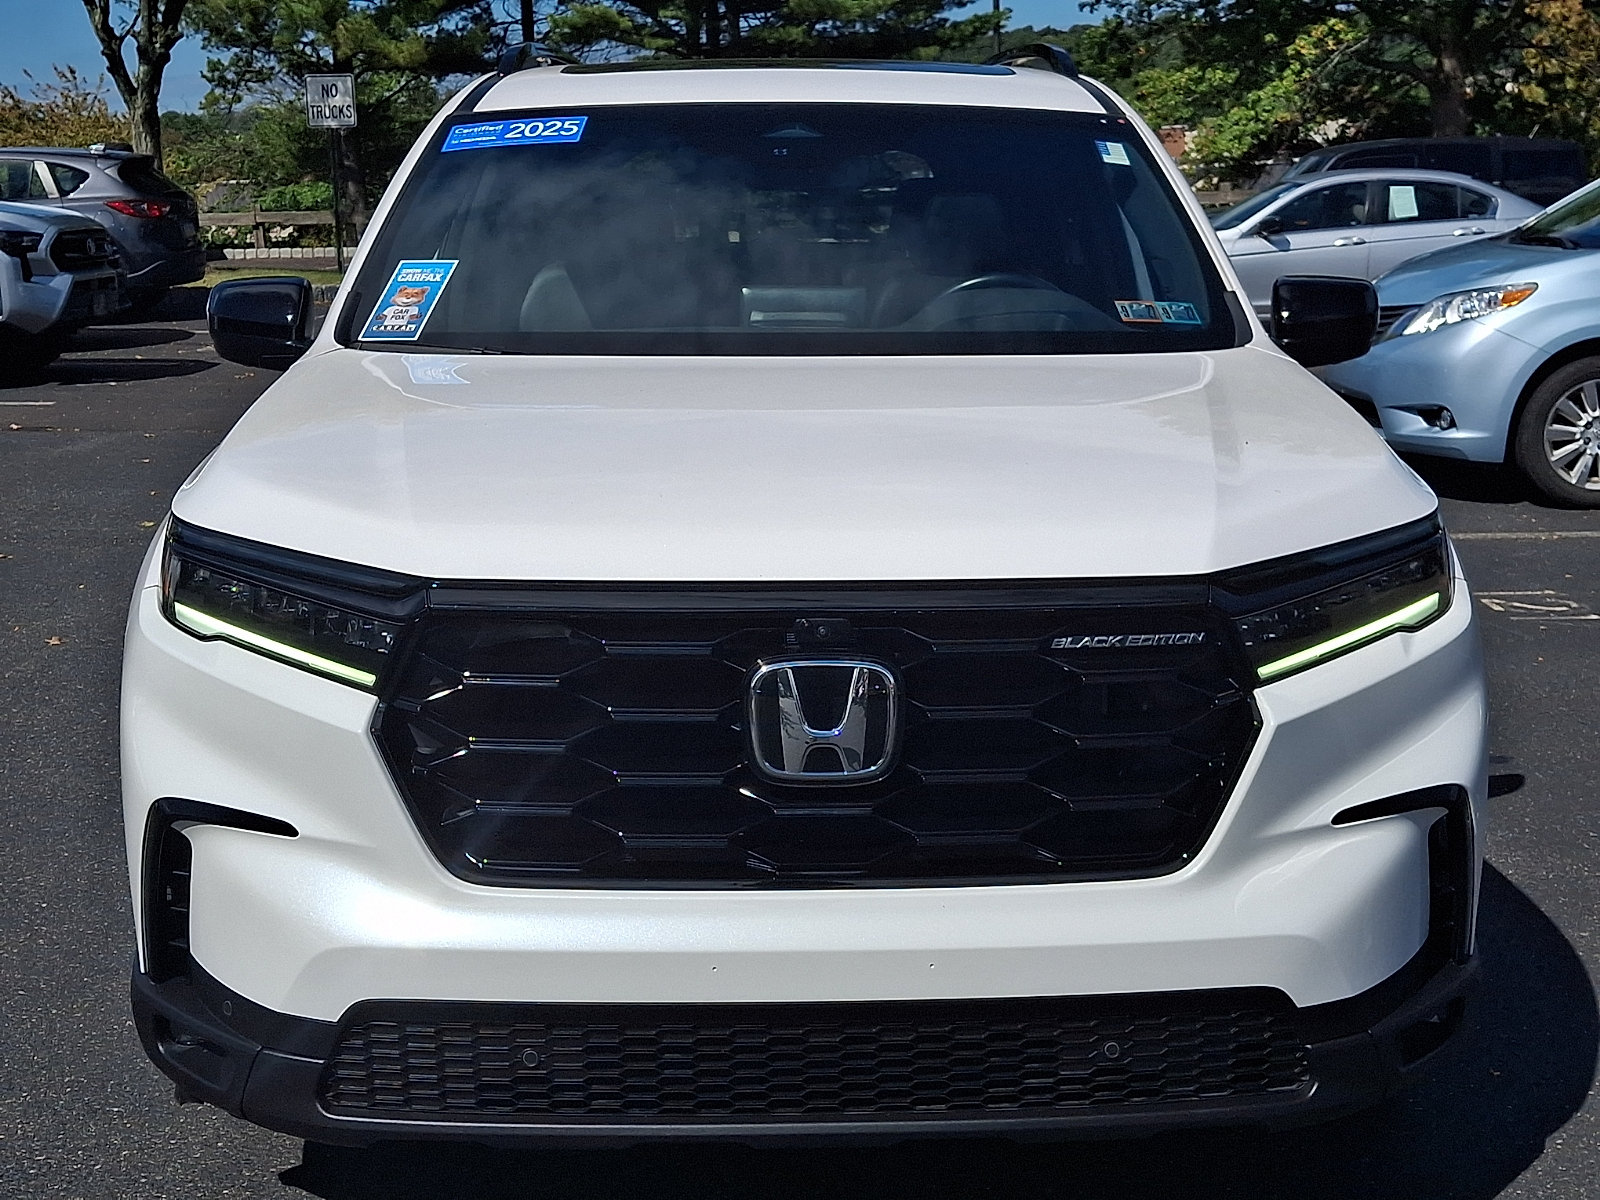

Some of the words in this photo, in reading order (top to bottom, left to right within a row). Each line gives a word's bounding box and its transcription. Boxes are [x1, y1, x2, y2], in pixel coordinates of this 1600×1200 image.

[321, 83, 338, 98] NO
[310, 104, 353, 119] TRUCKS
[454, 124, 504, 134] Certified
[504, 120, 581, 139] 2025
[397, 273, 443, 282] CARFAX
[1051, 635, 1124, 649] BLACK
[1126, 632, 1205, 647] EDITION
